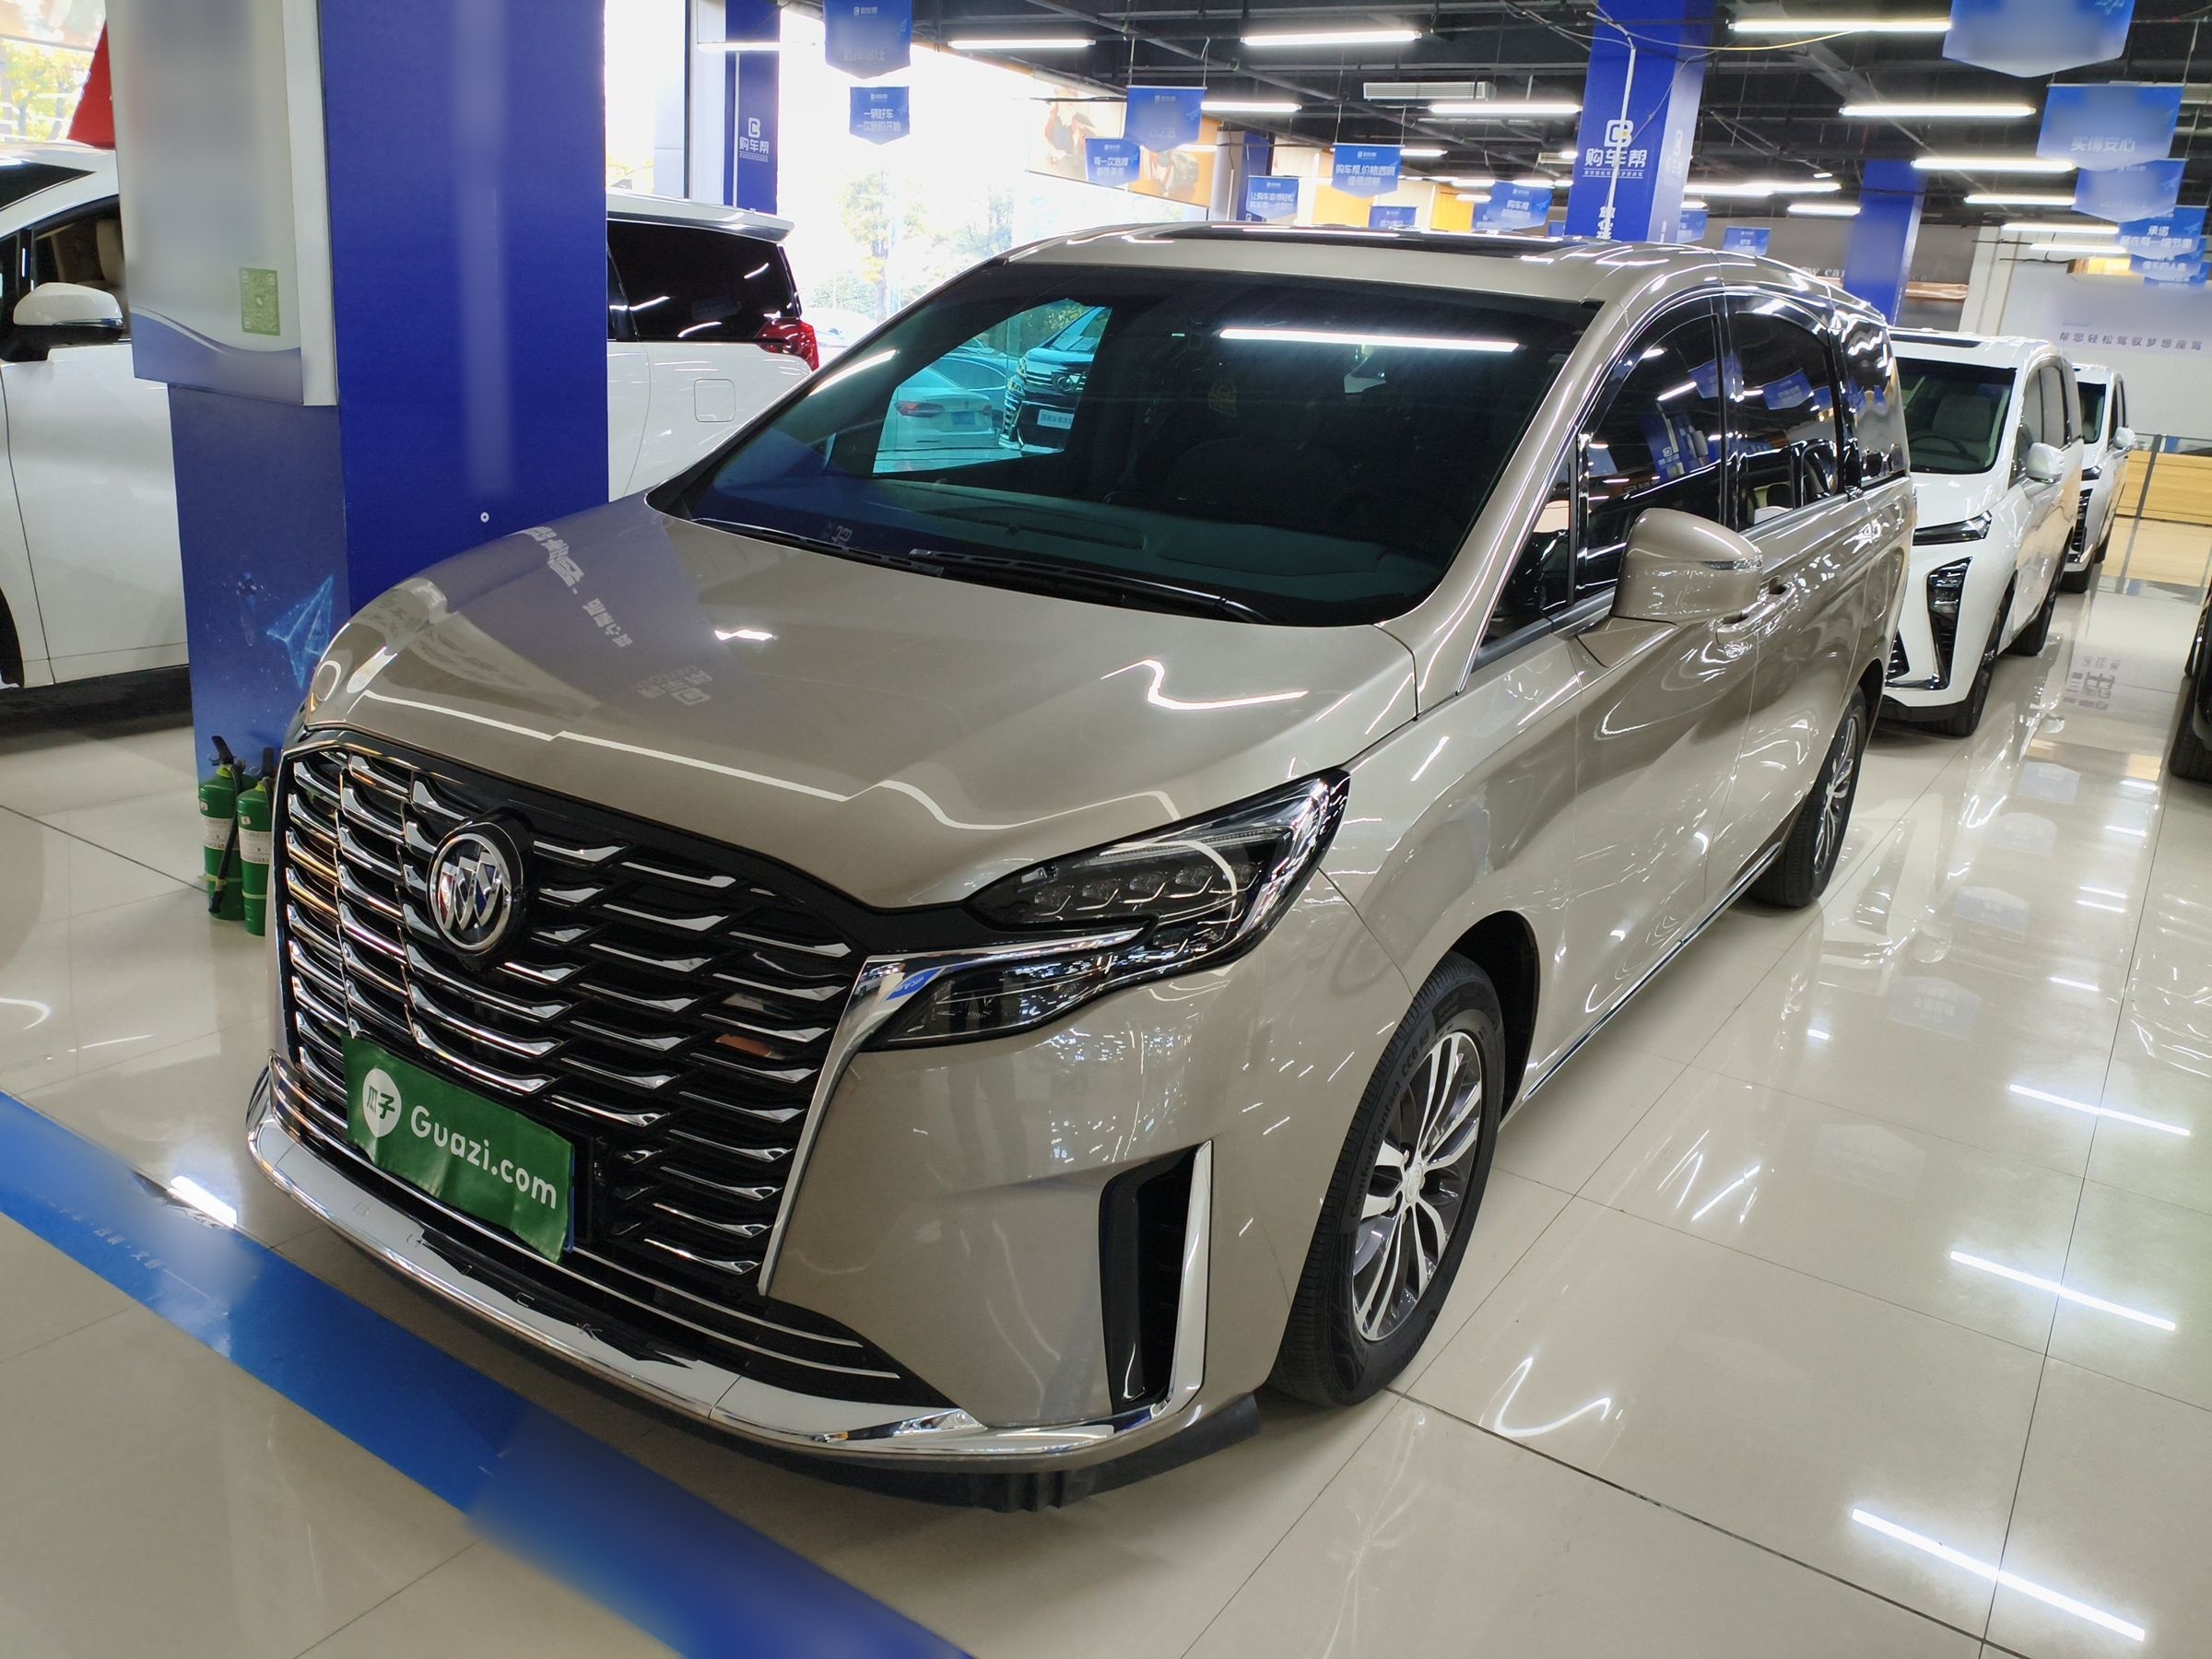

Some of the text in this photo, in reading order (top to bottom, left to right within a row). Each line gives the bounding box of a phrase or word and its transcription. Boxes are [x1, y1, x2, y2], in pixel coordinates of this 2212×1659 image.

[739, 136, 769, 154] 购车帮
[2070, 135, 2136, 152] 买得安心
[1584, 148, 1648, 168] 购车帮
[2147, 225, 2171, 237] 承诺
[2059, 331, 2203, 350] 帮您轻松驾驭梦想座驾
[410, 1105, 557, 1209] Guazi.com
